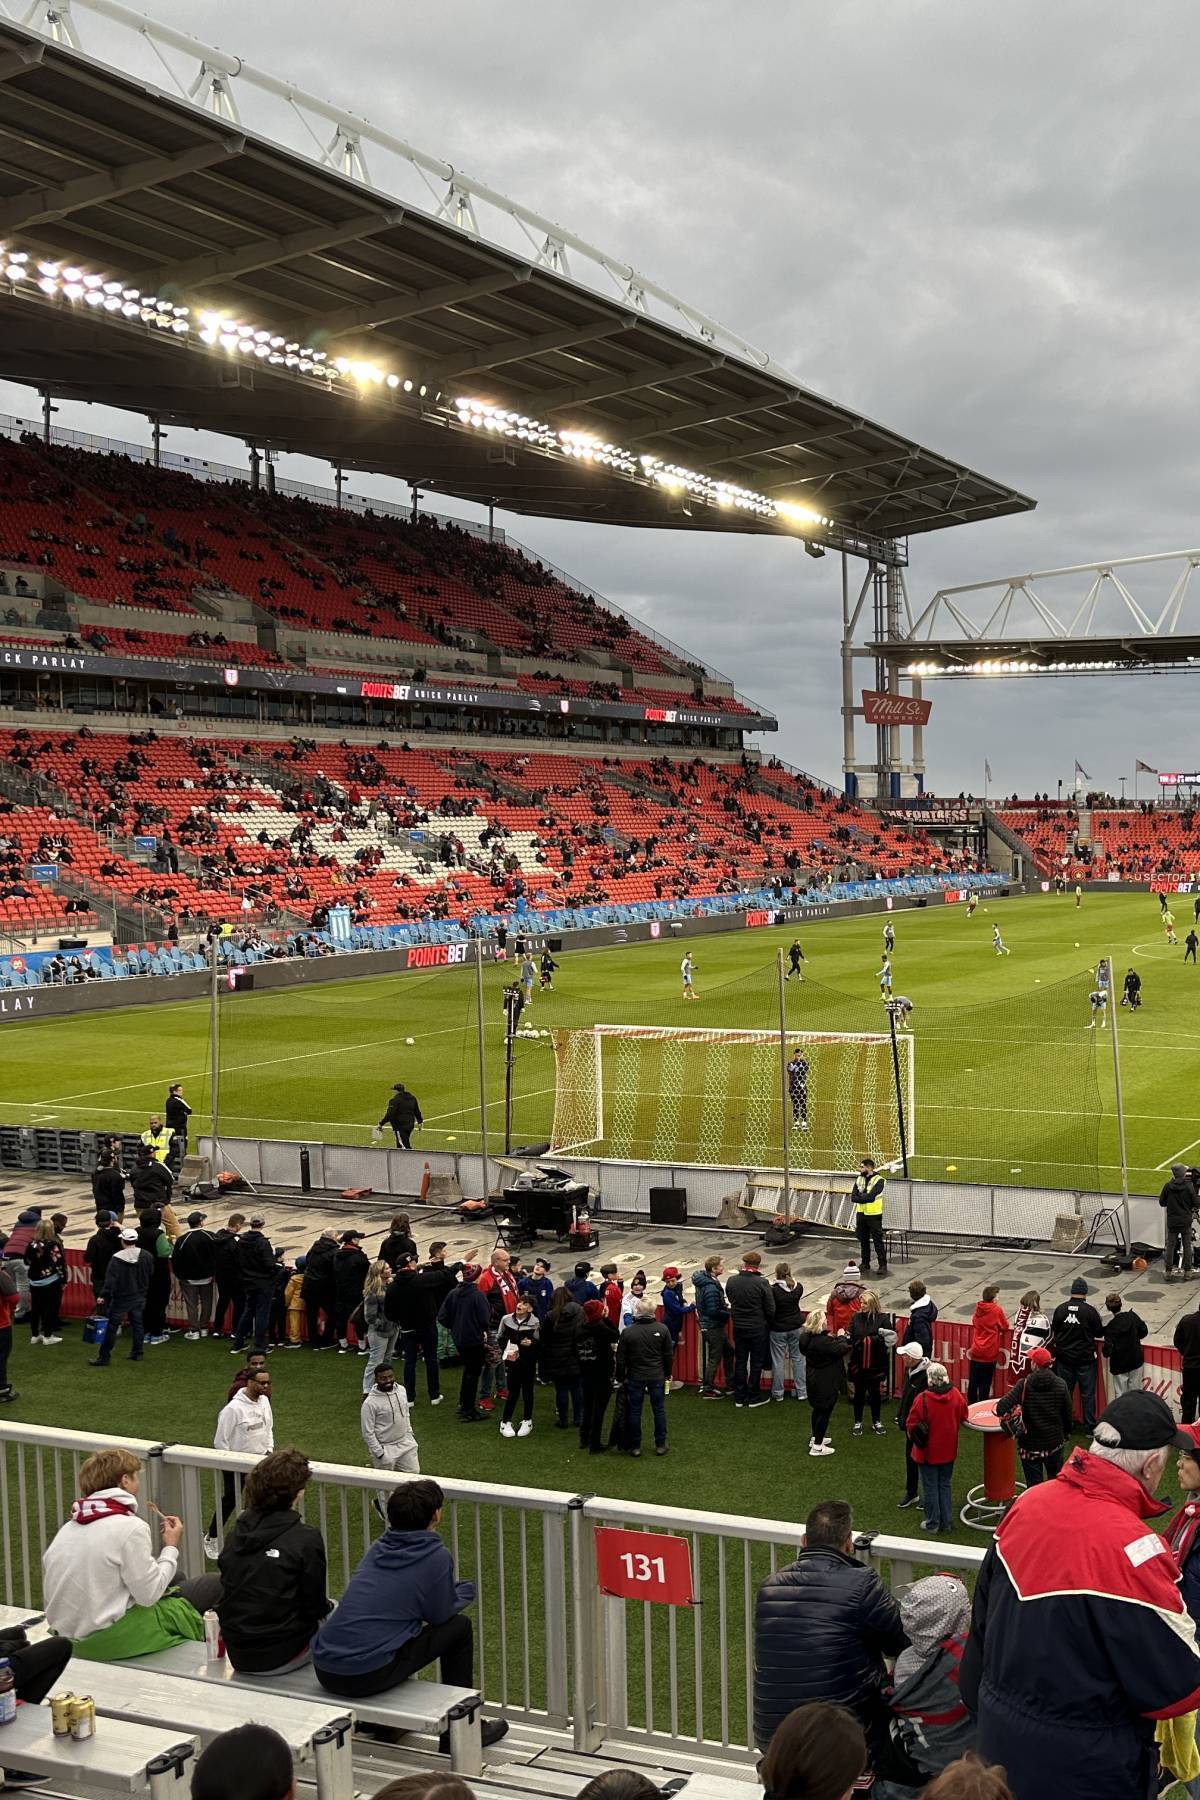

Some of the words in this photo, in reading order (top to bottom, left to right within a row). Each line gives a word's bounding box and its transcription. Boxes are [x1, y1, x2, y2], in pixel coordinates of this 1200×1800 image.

[32, 655, 85, 669] PARLAY
[361, 682, 411, 700] POINTSBET
[415, 690, 441, 699] QUICK
[447, 692, 479, 702] PARLAY
[869, 698, 904, 714] Mill
[905, 809, 968, 821] FORTRESS
[1149, 882, 1194, 893] POINTSBET
[407, 943, 468, 968] POINTSBET
[620, 1552, 666, 1584] 131
